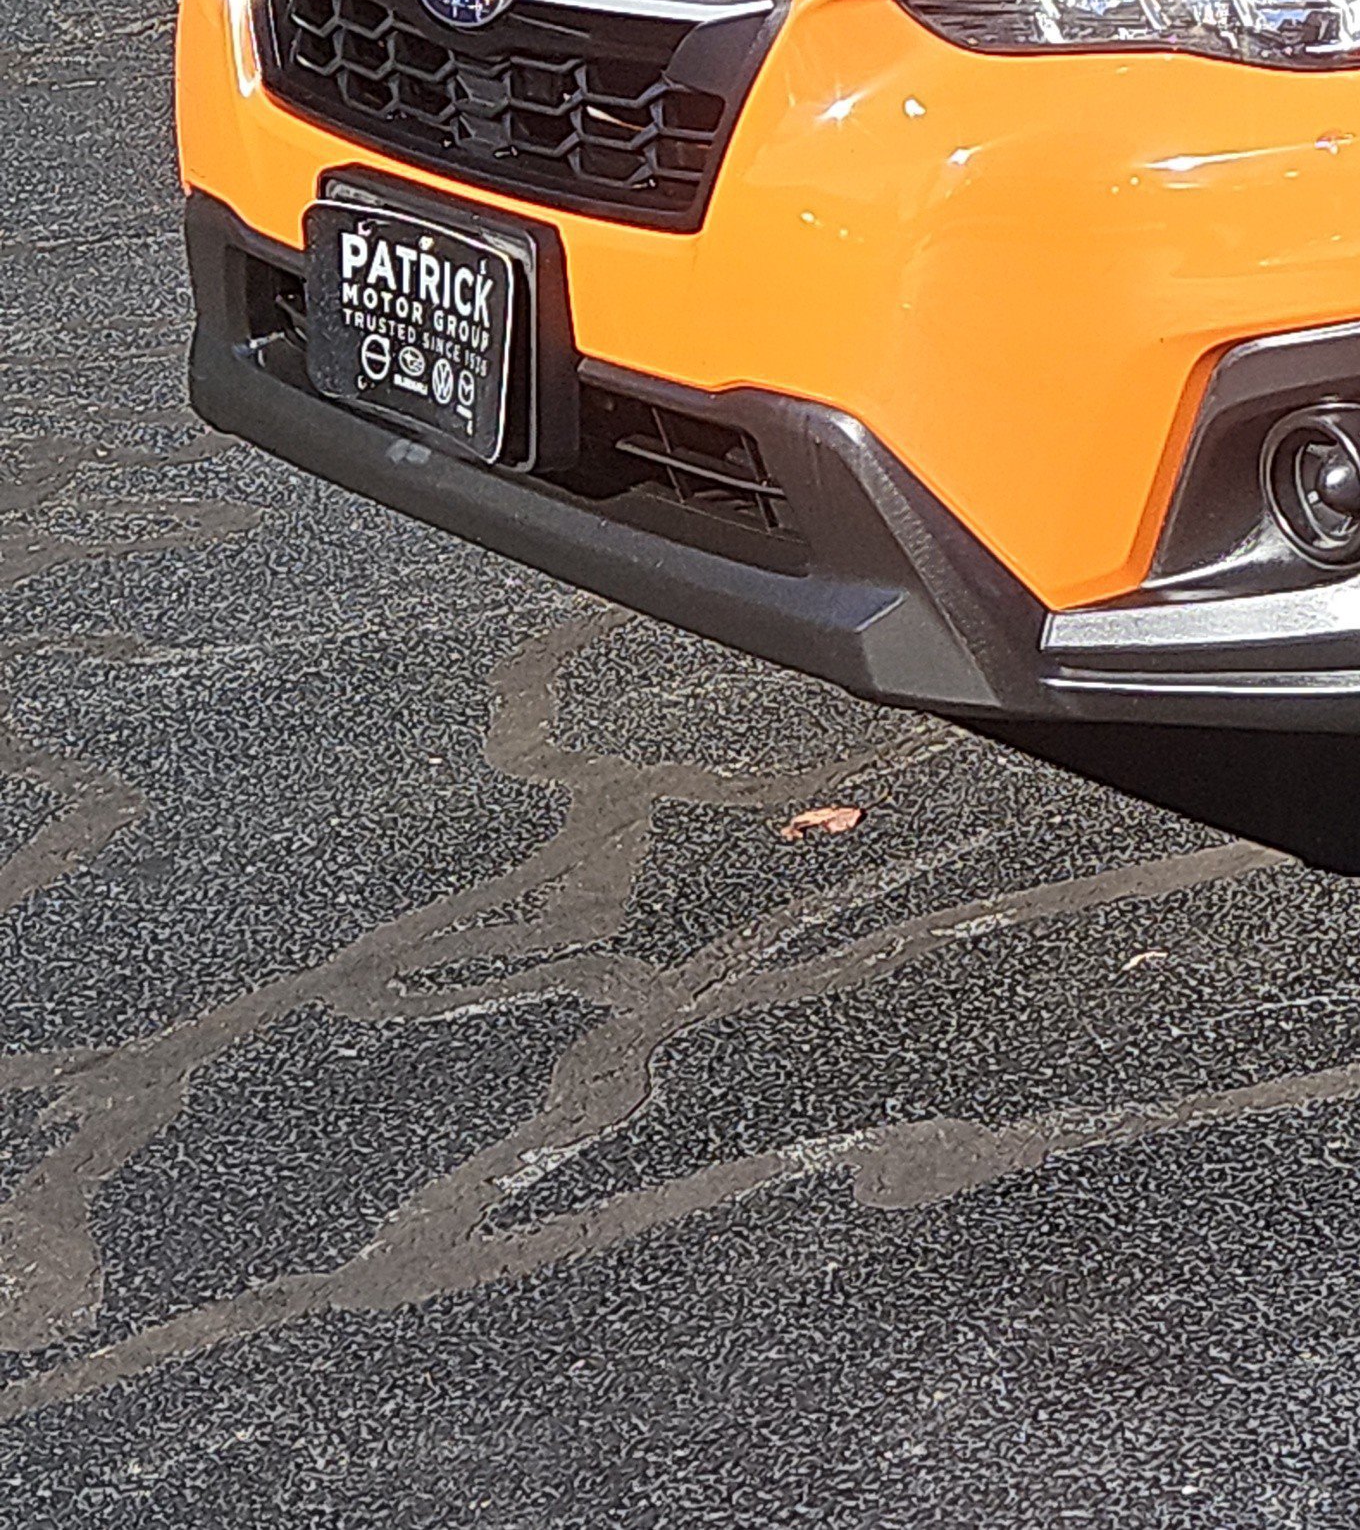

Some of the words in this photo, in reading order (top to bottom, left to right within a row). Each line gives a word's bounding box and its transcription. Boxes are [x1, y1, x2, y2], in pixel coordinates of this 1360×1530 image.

[340, 232, 493, 328] PATRICK
[341, 282, 423, 325] MOTOR
[433, 310, 490, 352] GROUP
[343, 308, 416, 343] TRUSTED
[422, 331, 461, 362] SINCE
